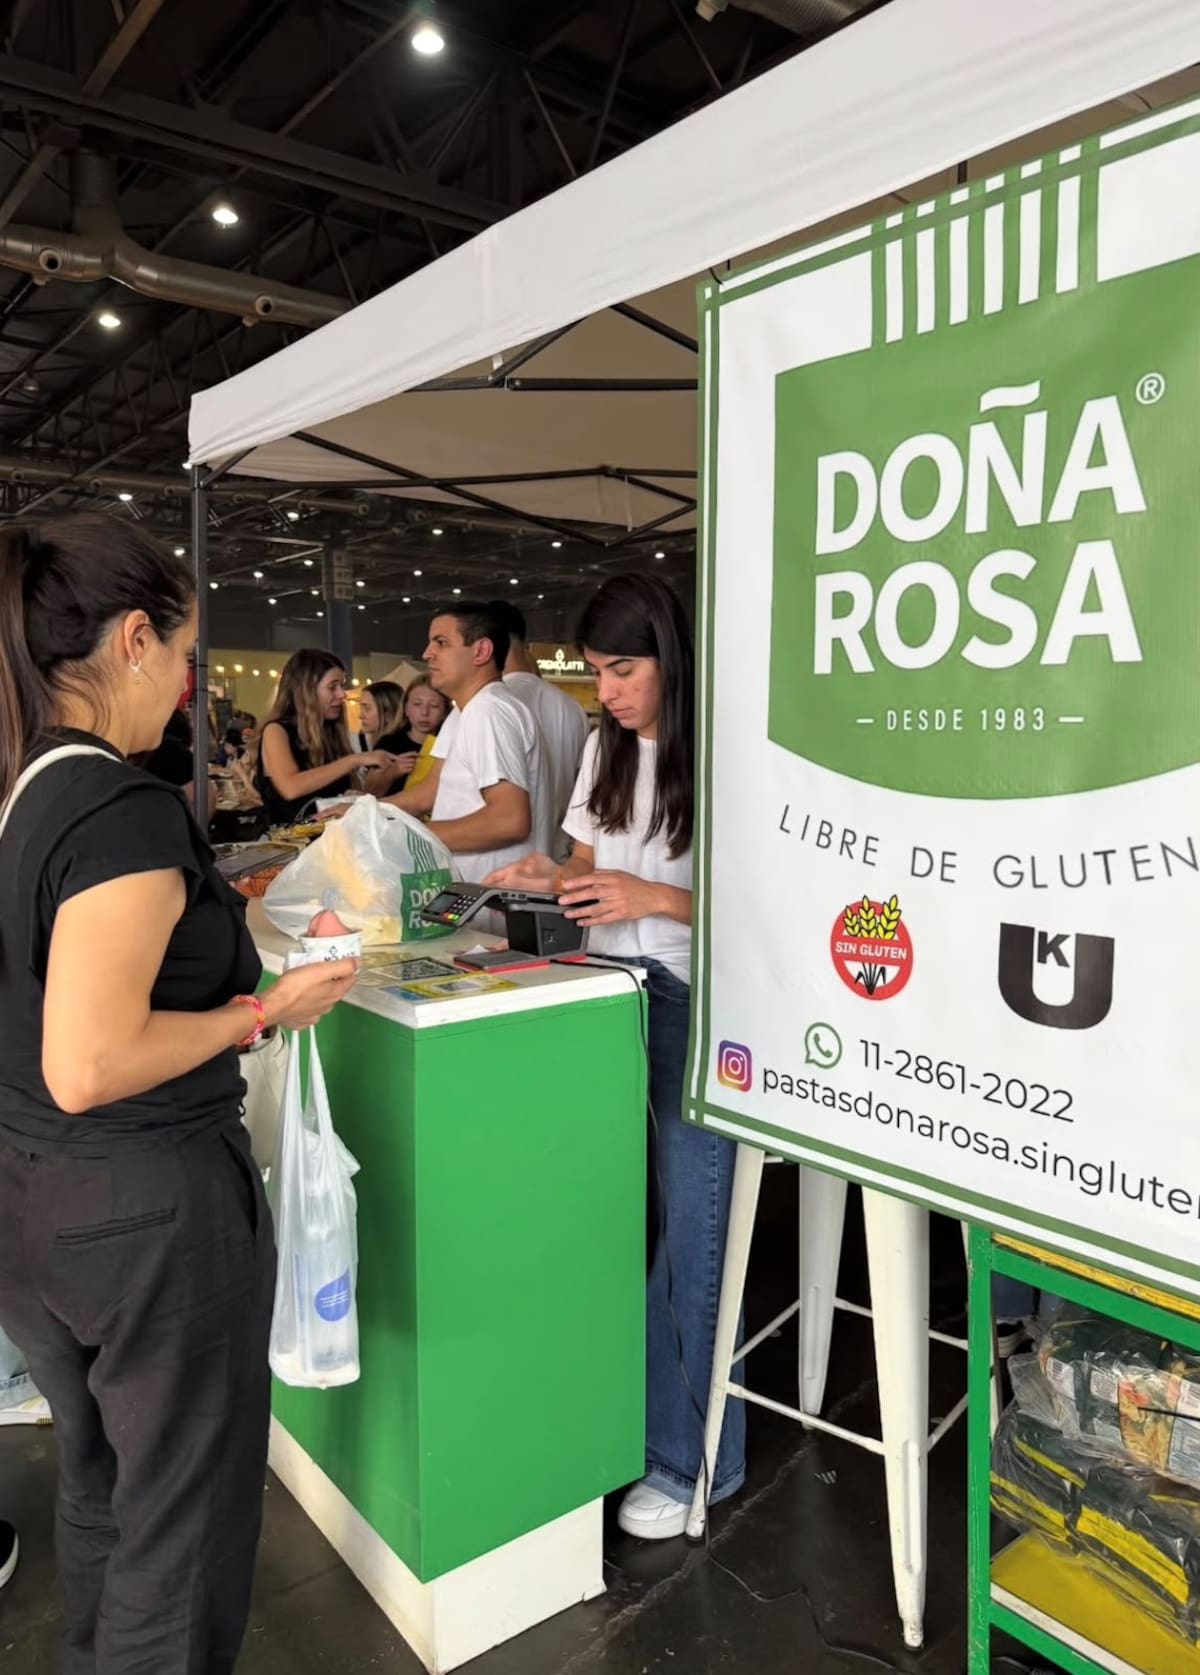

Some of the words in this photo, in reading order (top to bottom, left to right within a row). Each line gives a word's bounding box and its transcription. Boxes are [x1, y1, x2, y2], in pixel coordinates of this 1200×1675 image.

[815, 380, 1148, 556] DOÑA
[814, 539, 1144, 675] ROSA
[887, 708, 964, 731] DESDE
[980, 707, 1045, 731] 1983
[779, 804, 880, 867] LIBRE
[910, 846, 958, 884] DE
[993, 836, 1200, 889] GLUTEN
[410, 882, 447, 908] DOÑ
[835, 941, 857, 954] SIN
[860, 943, 907, 960] GLUTEN
[859, 1039, 1075, 1123] 11-2861-2022
[763, 1068, 1200, 1220] pastasdonarosa.singlute
